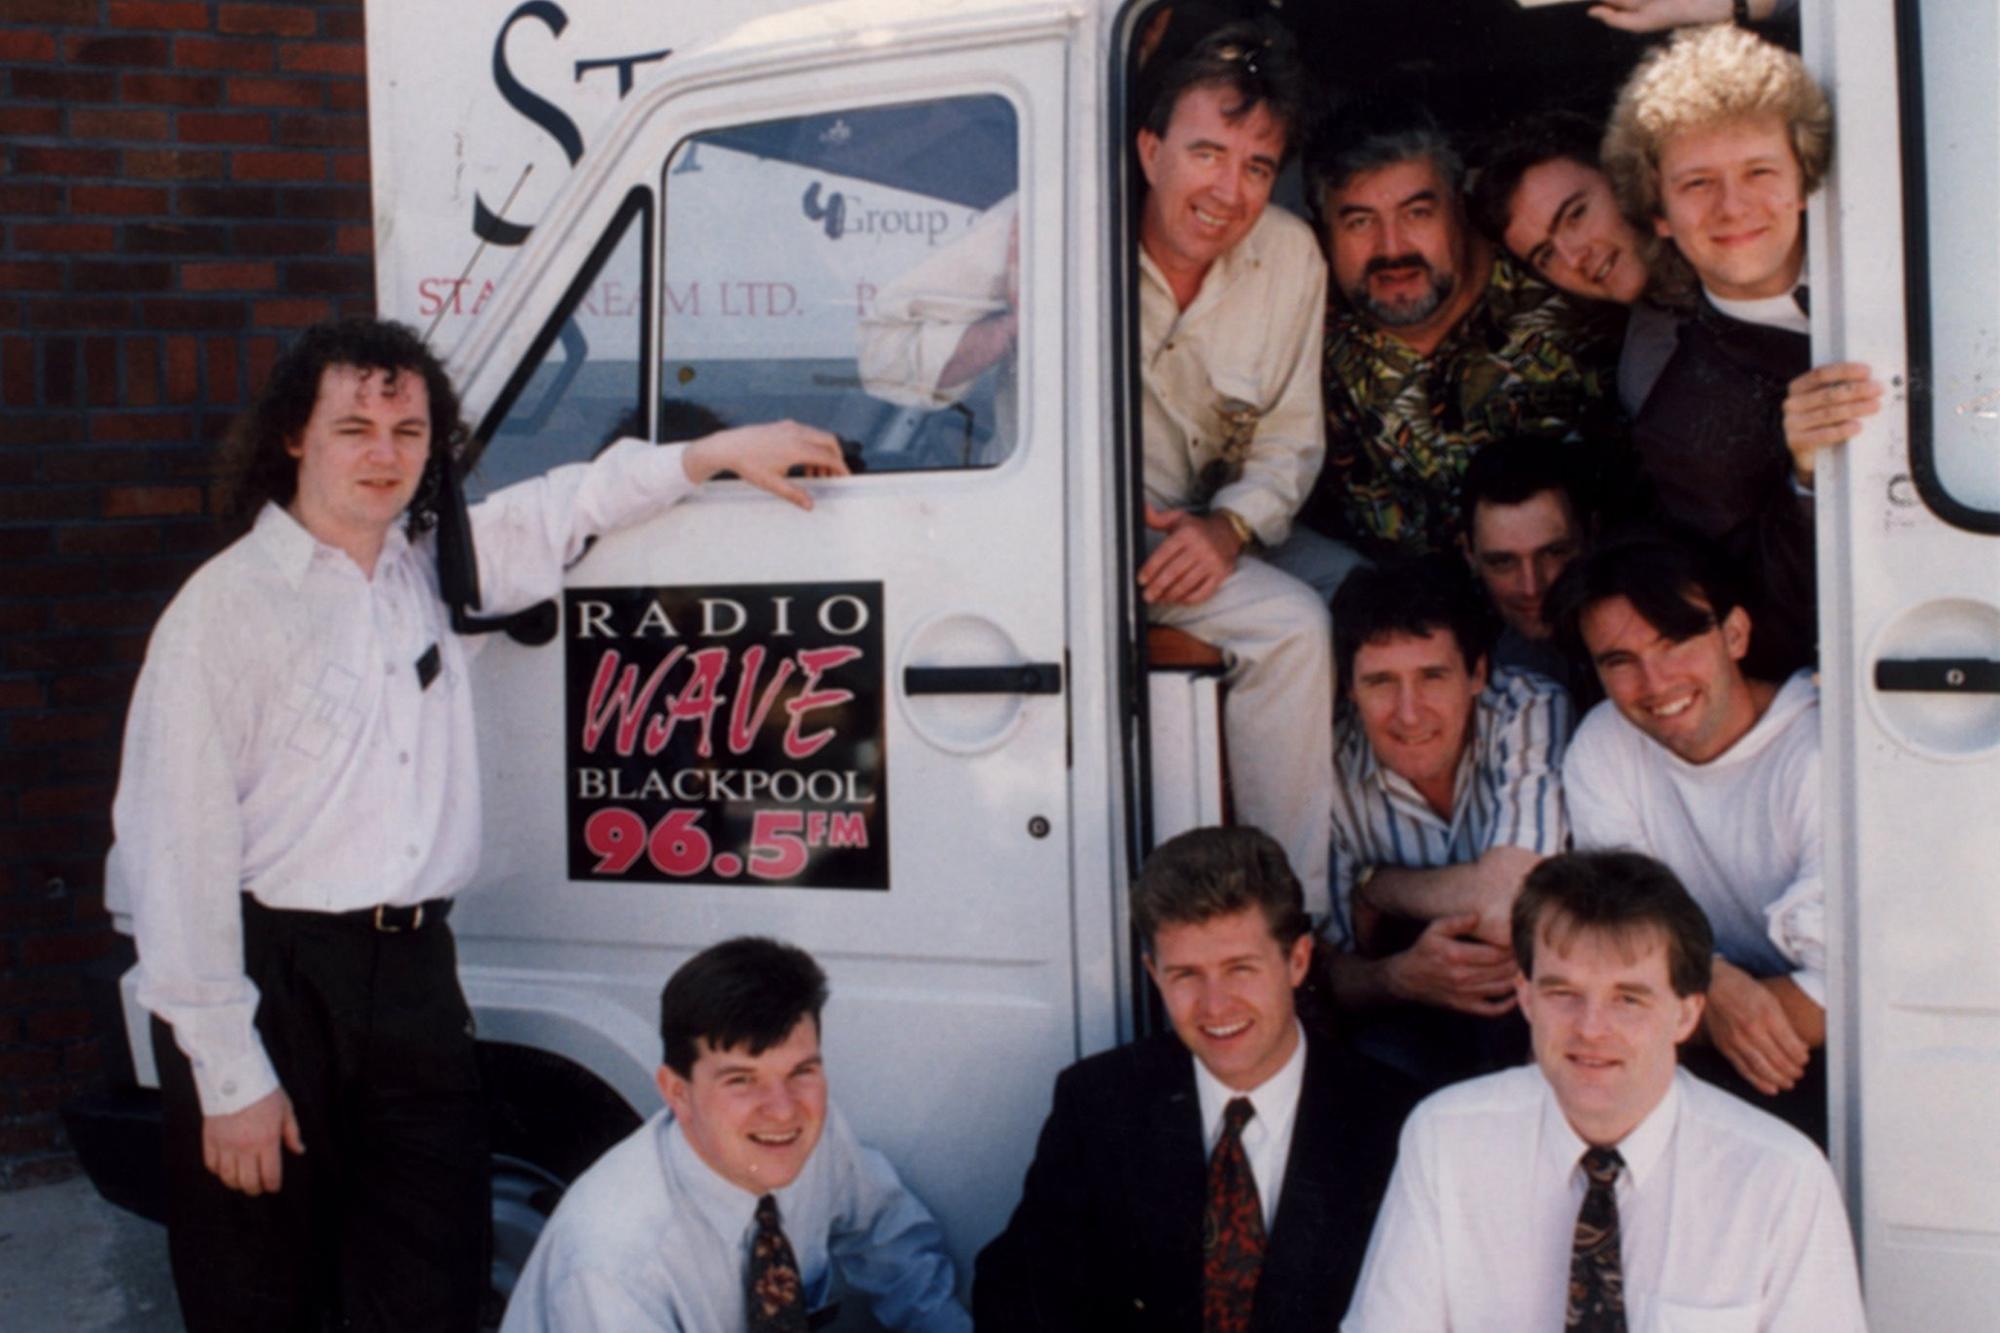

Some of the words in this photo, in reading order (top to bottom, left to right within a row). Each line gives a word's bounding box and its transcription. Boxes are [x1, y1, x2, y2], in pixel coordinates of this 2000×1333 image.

[844, 195, 950, 247] Group
[719, 280, 804, 318] LTD.
[576, 594, 870, 639] RADIO
[583, 645, 863, 758] WAVE
[577, 768, 876, 804] BLACKPOOL
